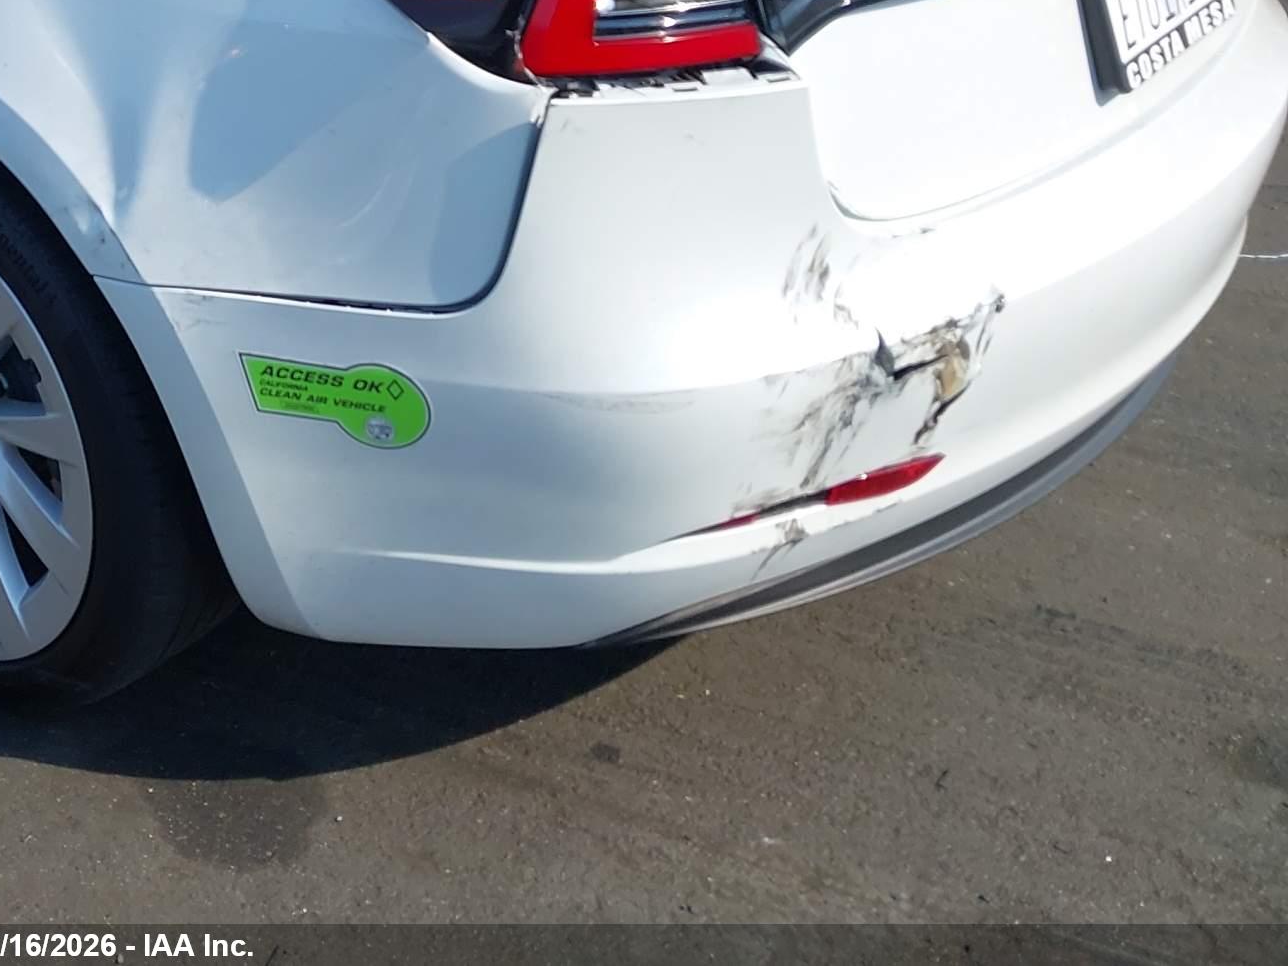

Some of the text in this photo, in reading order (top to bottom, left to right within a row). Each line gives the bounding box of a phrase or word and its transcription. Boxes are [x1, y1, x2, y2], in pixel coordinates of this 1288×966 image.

[1126, 29, 1187, 90] COSTA
[261, 365, 383, 394] ACCESS OK
[260, 387, 302, 400] CLEAN
[306, 394, 328, 405] AIR
[333, 398, 387, 412] VEHICLE
